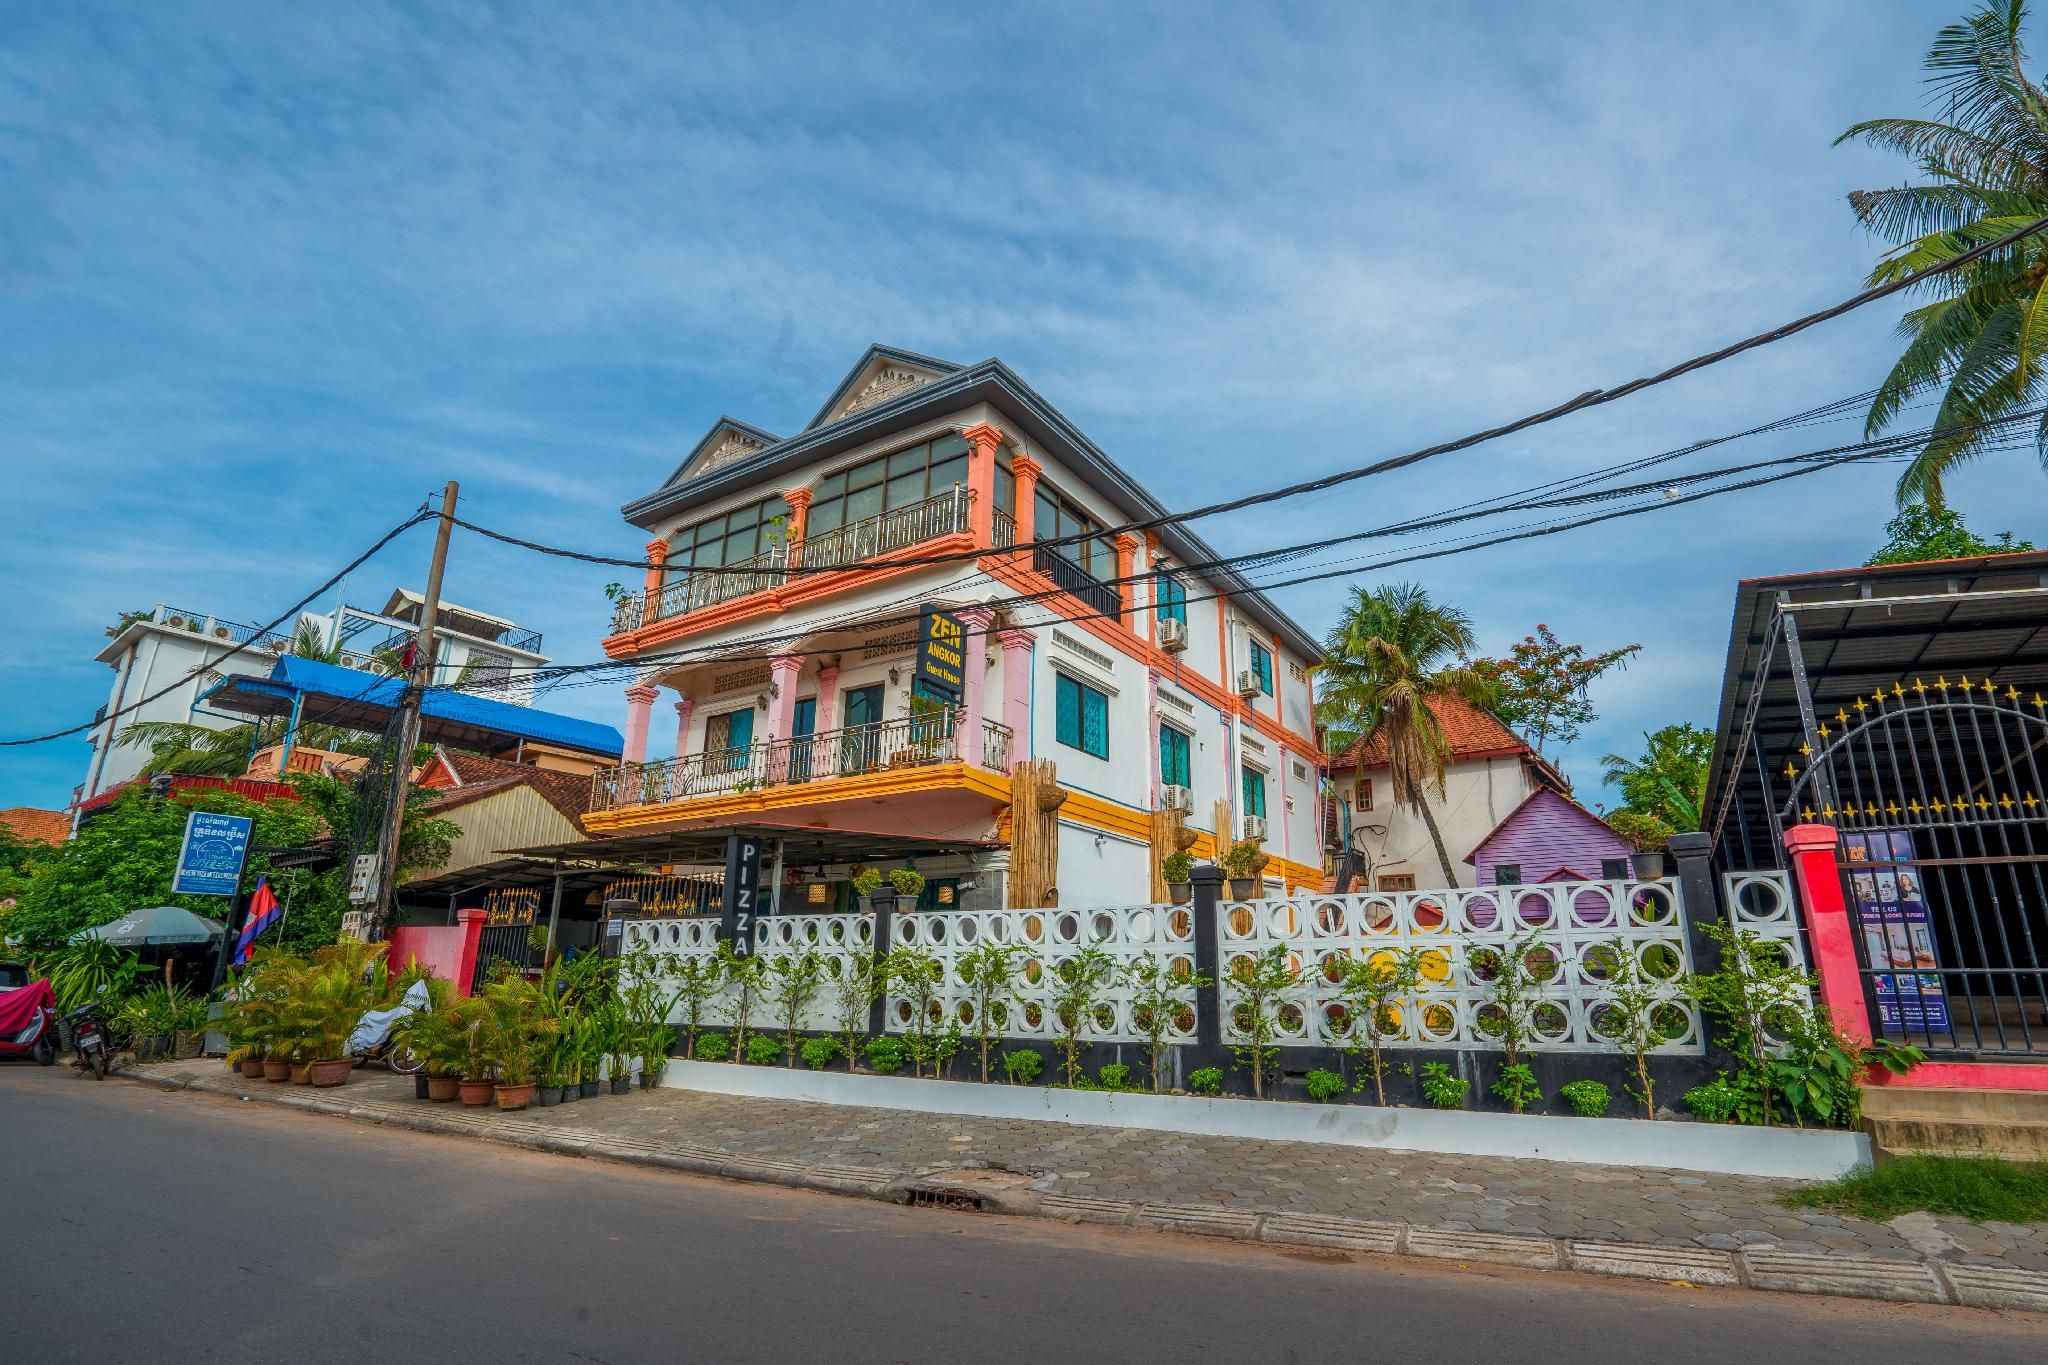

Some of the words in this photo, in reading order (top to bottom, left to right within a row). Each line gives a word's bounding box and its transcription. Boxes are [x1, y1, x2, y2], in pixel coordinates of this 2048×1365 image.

[930, 614, 960, 649] ZEN
[928, 641, 960, 668] ANGKOR
[926, 661, 943, 677] Guest
[943, 668, 960, 684] House
[734, 844, 755, 955] PIZZA
